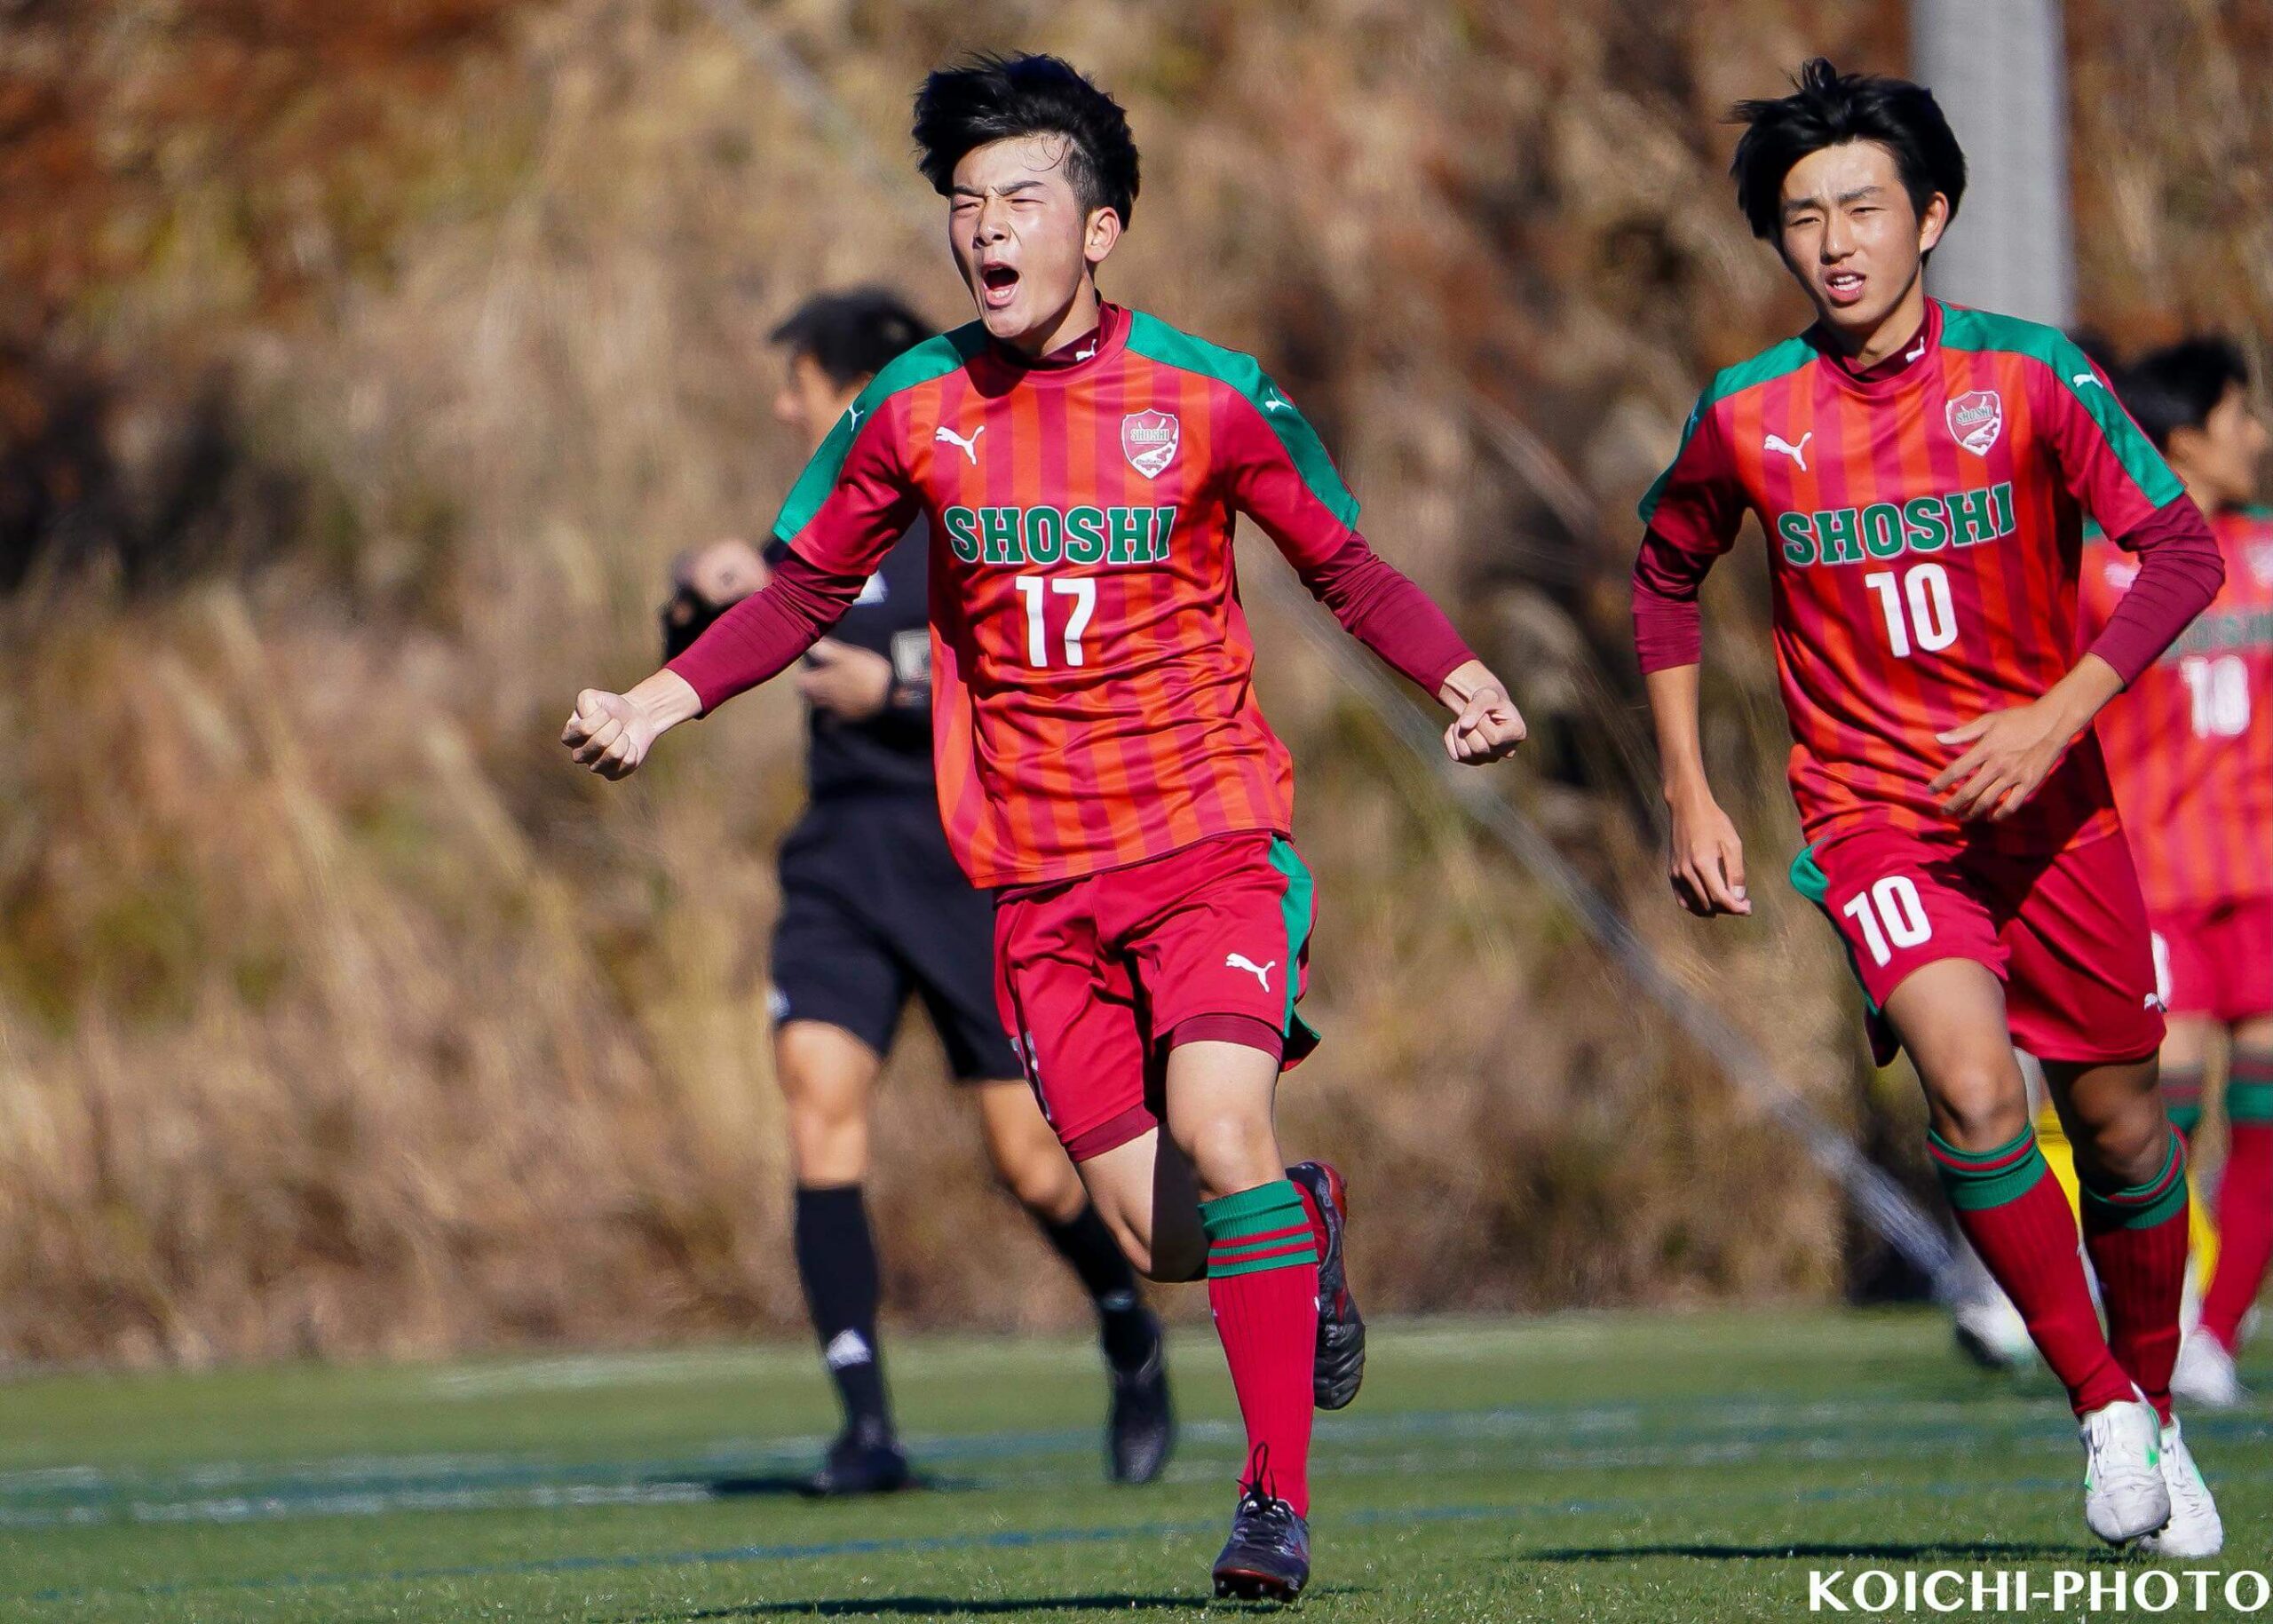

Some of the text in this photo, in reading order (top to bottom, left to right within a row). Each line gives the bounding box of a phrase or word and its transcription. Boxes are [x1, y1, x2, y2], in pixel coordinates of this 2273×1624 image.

[1130, 429, 1170, 441] SHOSHI
[1956, 405, 1993, 424] SHOSHI
[944, 505, 1176, 565] SHOSHI
[1778, 481, 2016, 567] SHOSHI
[1015, 575, 1097, 668] 17
[1865, 562, 1960, 658] 10
[1842, 875, 1933, 968] 10
